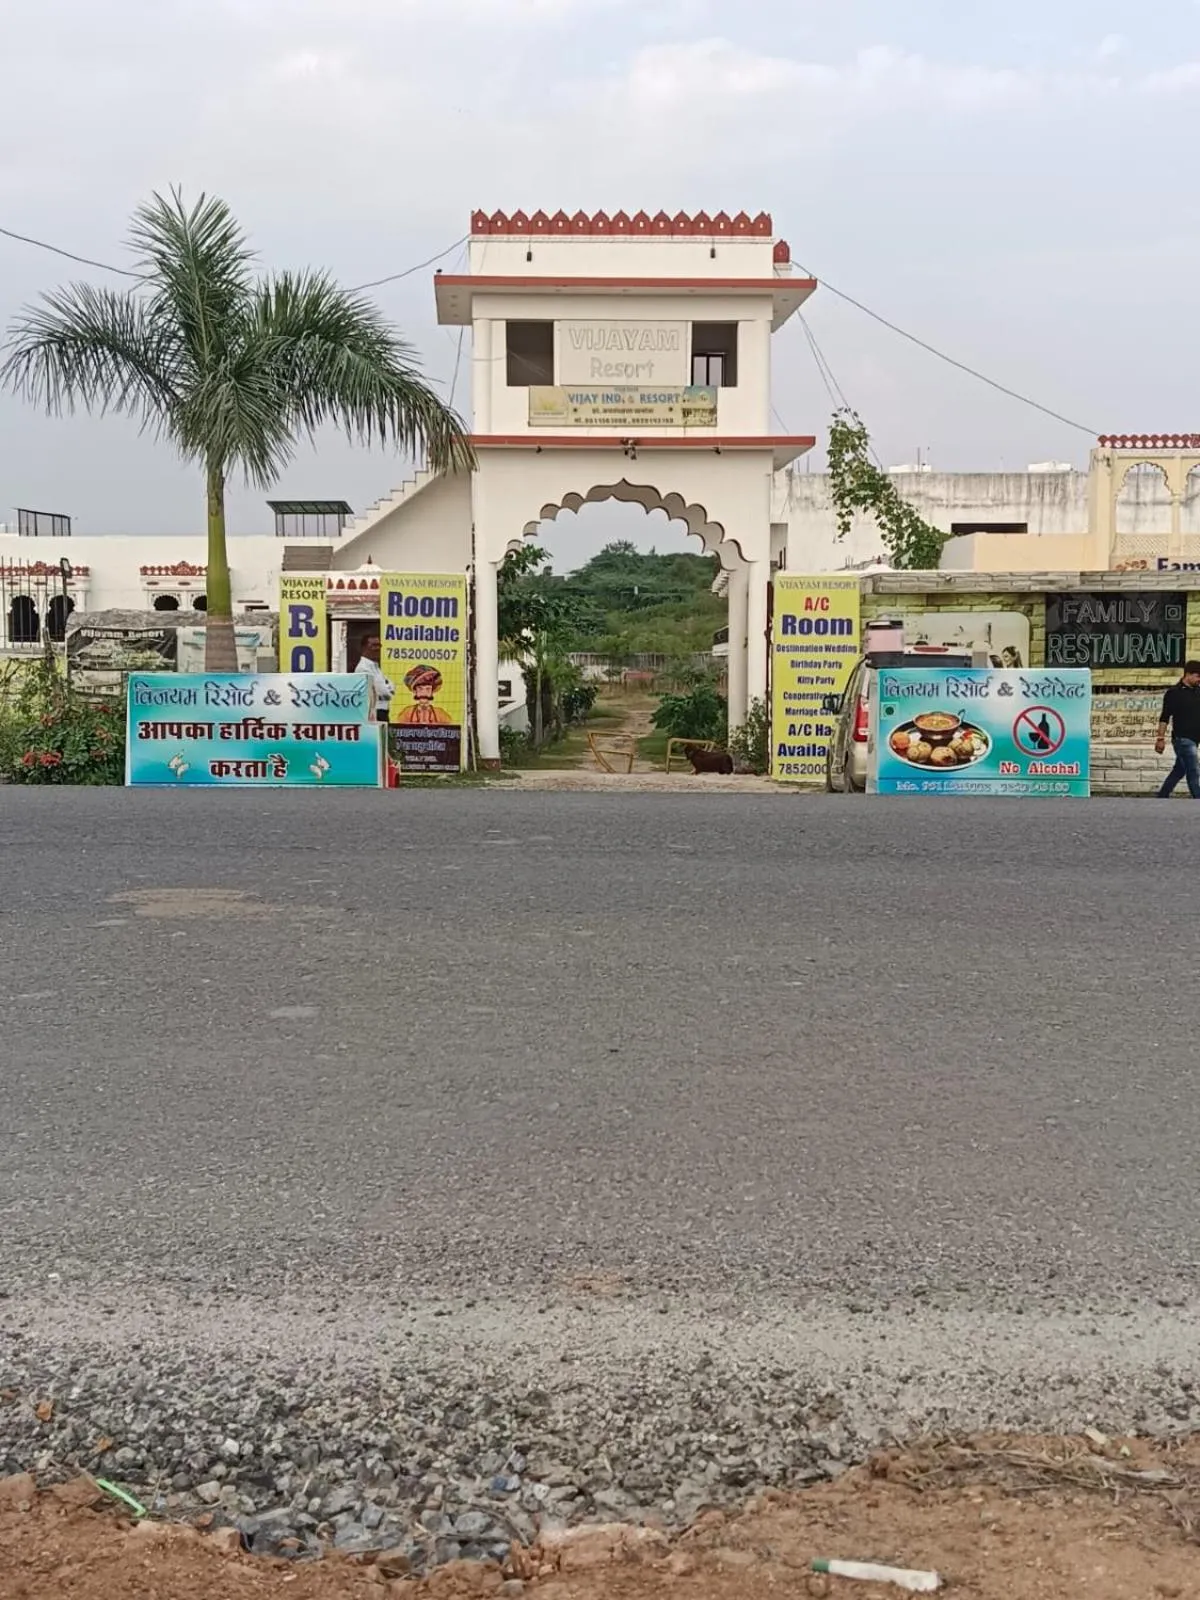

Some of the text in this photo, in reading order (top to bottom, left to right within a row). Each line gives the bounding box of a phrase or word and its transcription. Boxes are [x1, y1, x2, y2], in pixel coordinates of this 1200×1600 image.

[567, 327, 680, 351] VIJAYAM
[590, 356, 655, 378] Resort
[568, 393, 598, 404] VIJAY
[640, 393, 680, 404] RESORT
[282, 578, 323, 588] VIJAYAM
[385, 578, 462, 589] VIJAYAM RESORT
[779, 580, 857, 590] VIJAYAM RESORT
[281, 589, 326, 600] RESORT
[387, 591, 458, 618] Room
[804, 596, 830, 612] A/C
[1061, 599, 1157, 623] FAMILY
[781, 614, 853, 635] Room
[385, 624, 459, 642] Available
[386, 647, 458, 660] 7852000507
[824, 644, 857, 653] Wedding
[1048, 632, 1185, 663] RESTAURANT
[790, 659, 842, 669] Birthday Party
[815, 676, 835, 685] Party
[884, 676, 940, 697] विजयम
[946, 676, 993, 698] रिसोर्ट
[997, 682, 1014, 697] &
[134, 680, 197, 706] विजयम
[204, 680, 259, 707] रिसोर्ट
[263, 689, 282, 706] &
[138, 716, 361, 741] आपका हार्दिक स्वागत
[788, 723, 812, 736] A/C
[210, 754, 288, 778] करता है
[1000, 762, 1081, 775] No Alcohal
